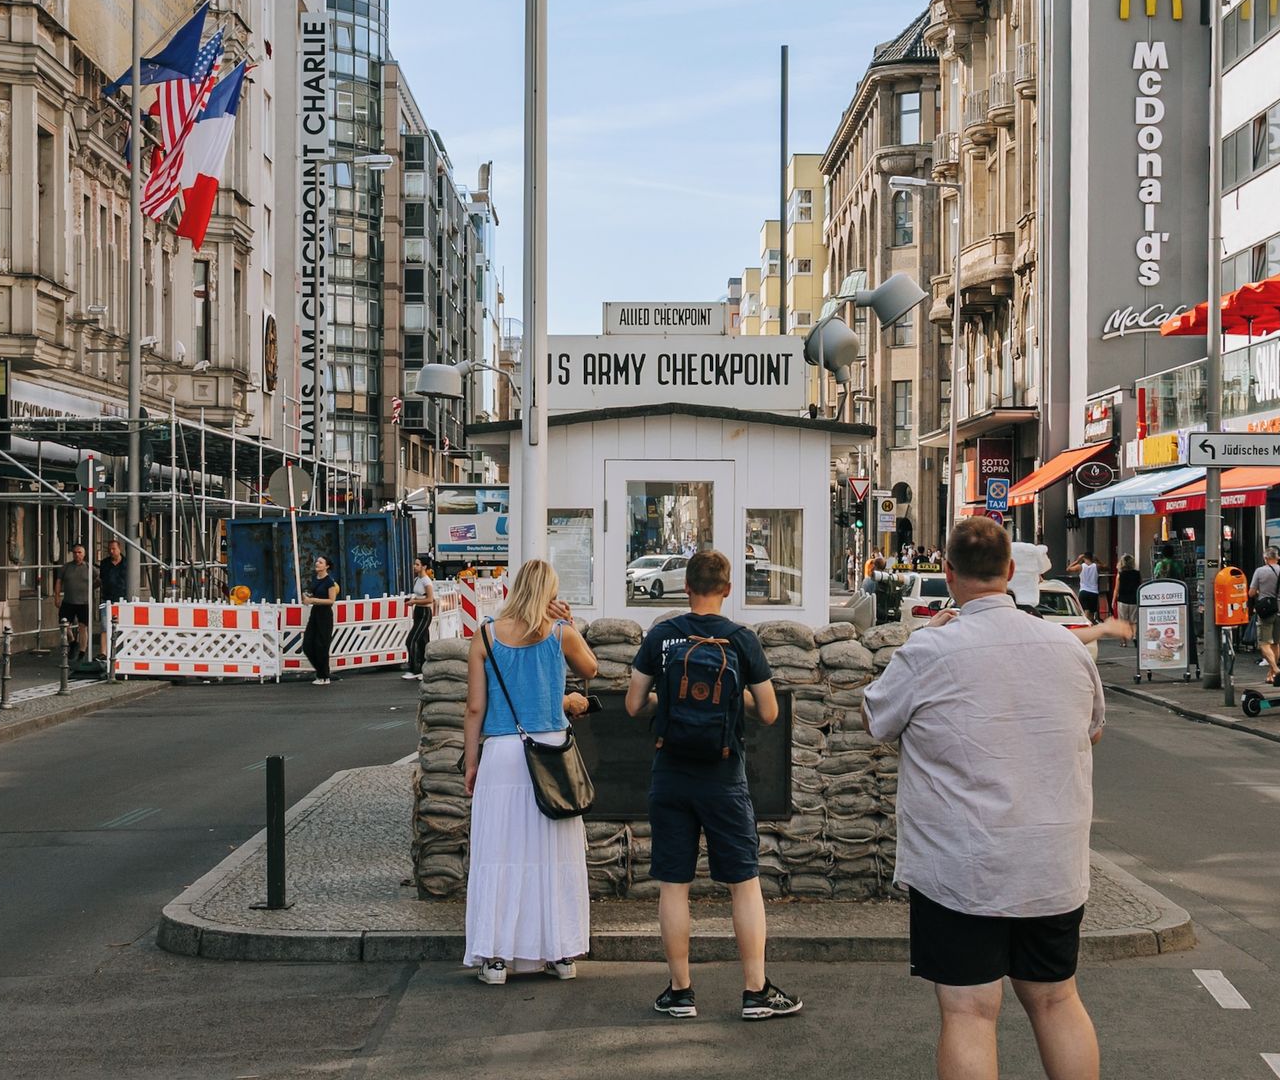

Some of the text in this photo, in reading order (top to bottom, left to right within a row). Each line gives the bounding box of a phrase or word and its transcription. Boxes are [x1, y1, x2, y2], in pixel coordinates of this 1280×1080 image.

[303, 22, 326, 136] CHARLIE
[1133, 42, 1170, 286] McDonald's
[302, 144, 326, 321] CHECKPOINT
[619, 308, 712, 326] ALLIED CHECKPOINT
[302, 329, 325, 375] AM
[583, 353, 646, 386] ARMY
[657, 353, 793, 386] CHECKPOINT
[1222, 443, 1269, 456] Jüdisches
[981, 458, 1010, 466] SOTTO
[981, 465, 1010, 473] SOPRA
[988, 500, 1006, 509] TAXI
[1142, 593, 1160, 601] SNACKS
[1166, 592, 1183, 600] COFFEE
